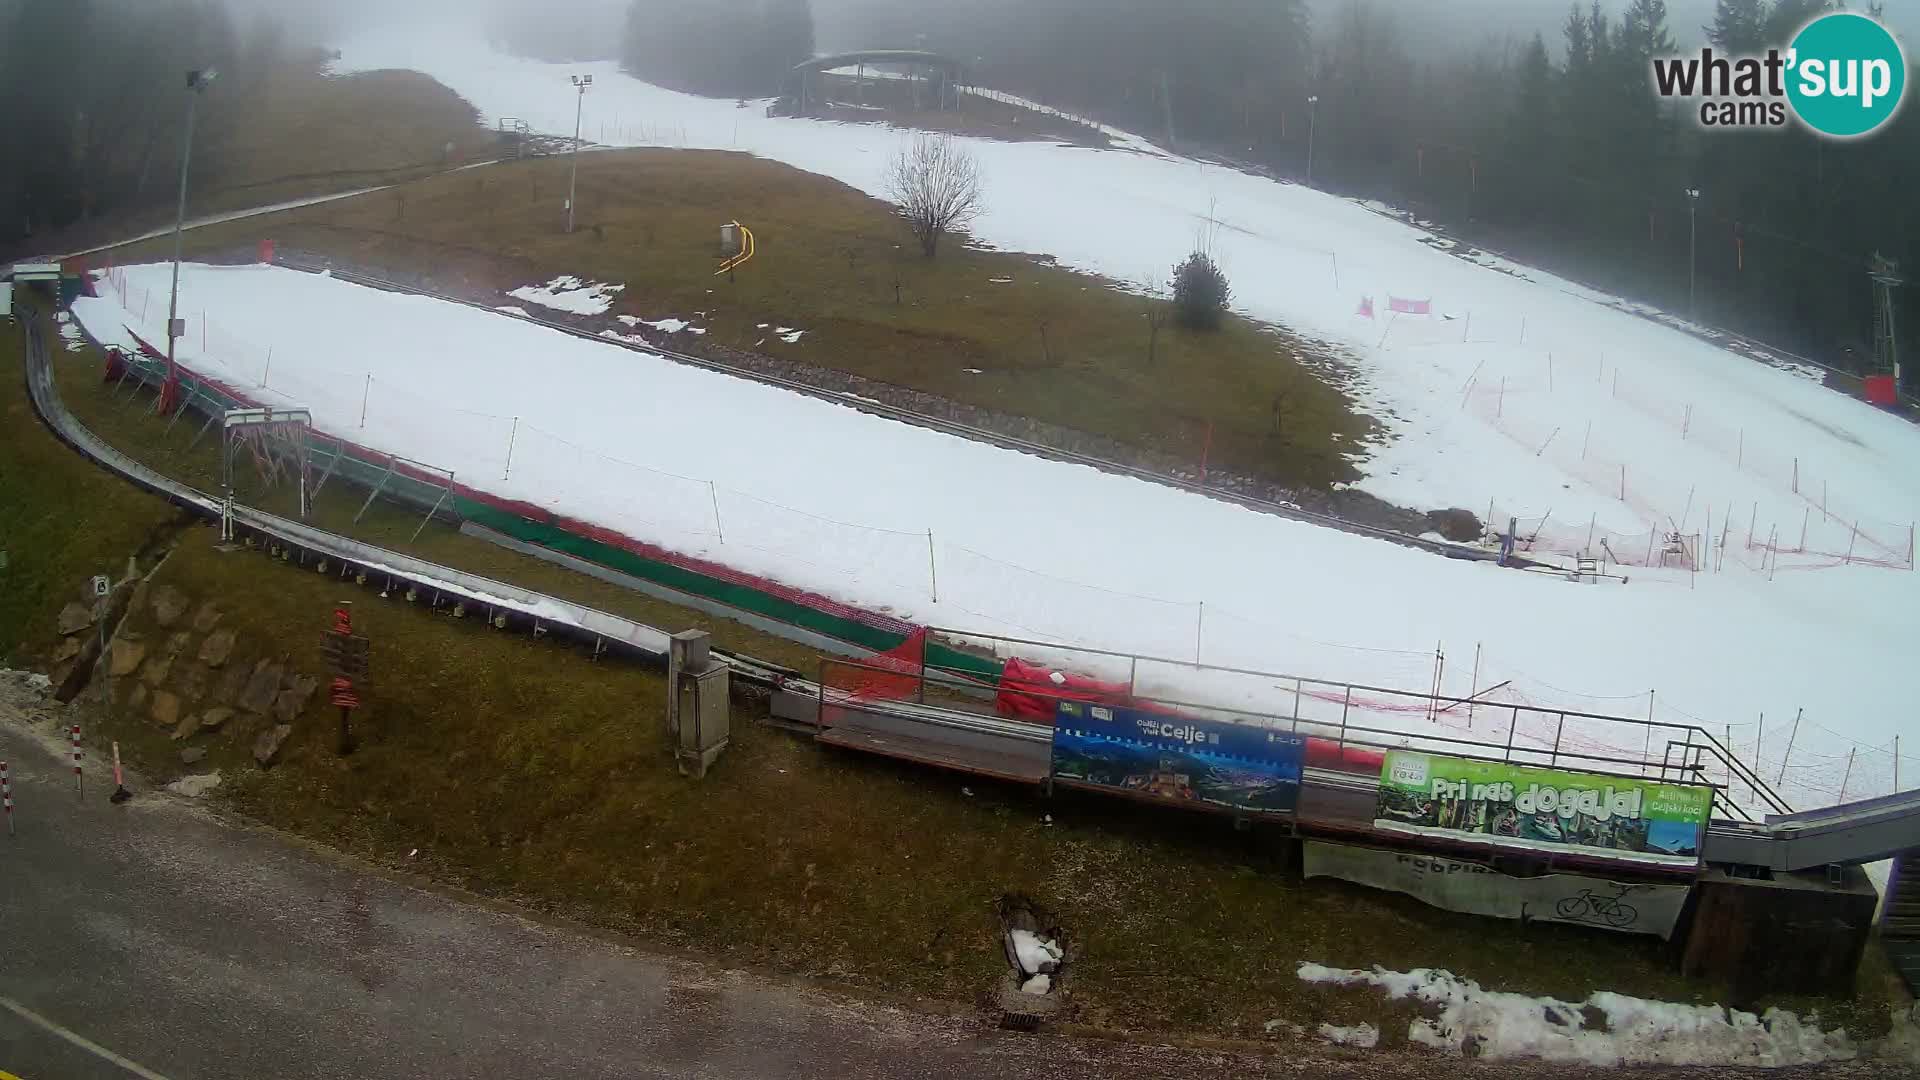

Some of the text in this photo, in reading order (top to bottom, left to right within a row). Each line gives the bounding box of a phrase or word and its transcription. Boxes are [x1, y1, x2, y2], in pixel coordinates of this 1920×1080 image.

[1160, 723, 1206, 745] Celje
[1430, 777, 1467, 801] Pri
[1472, 782, 1514, 802] nas
